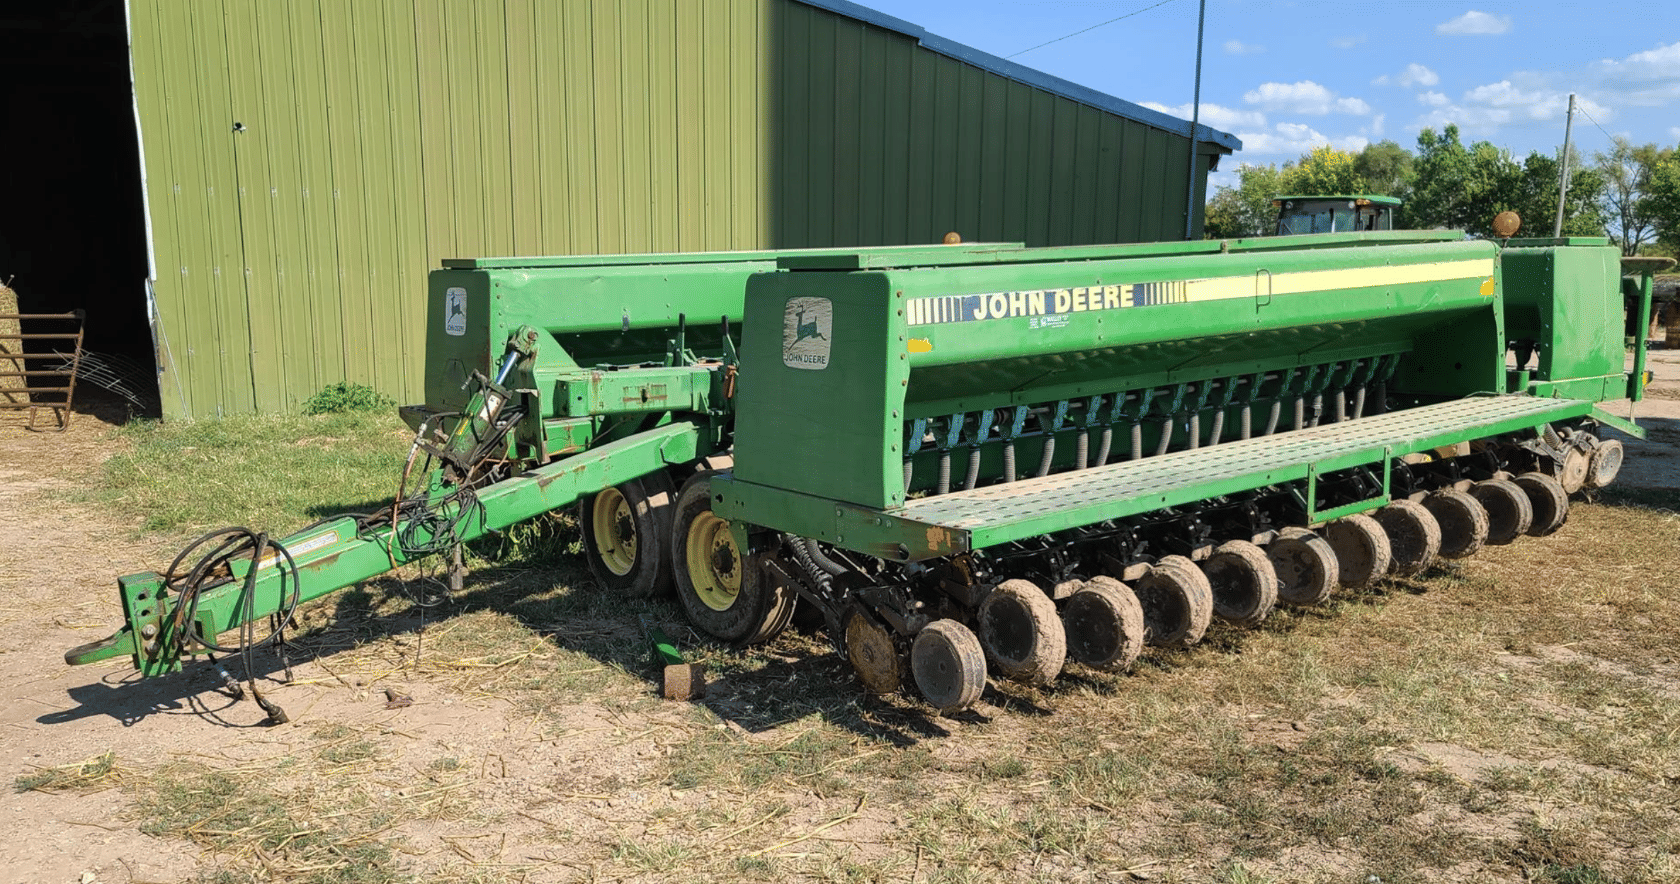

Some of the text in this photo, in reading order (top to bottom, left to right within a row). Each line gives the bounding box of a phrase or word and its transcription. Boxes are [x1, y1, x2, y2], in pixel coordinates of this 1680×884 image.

[973, 292, 1045, 320] JOHN
[1055, 284, 1133, 314] DEERE
[785, 353, 826, 364] JOHN DEERE
